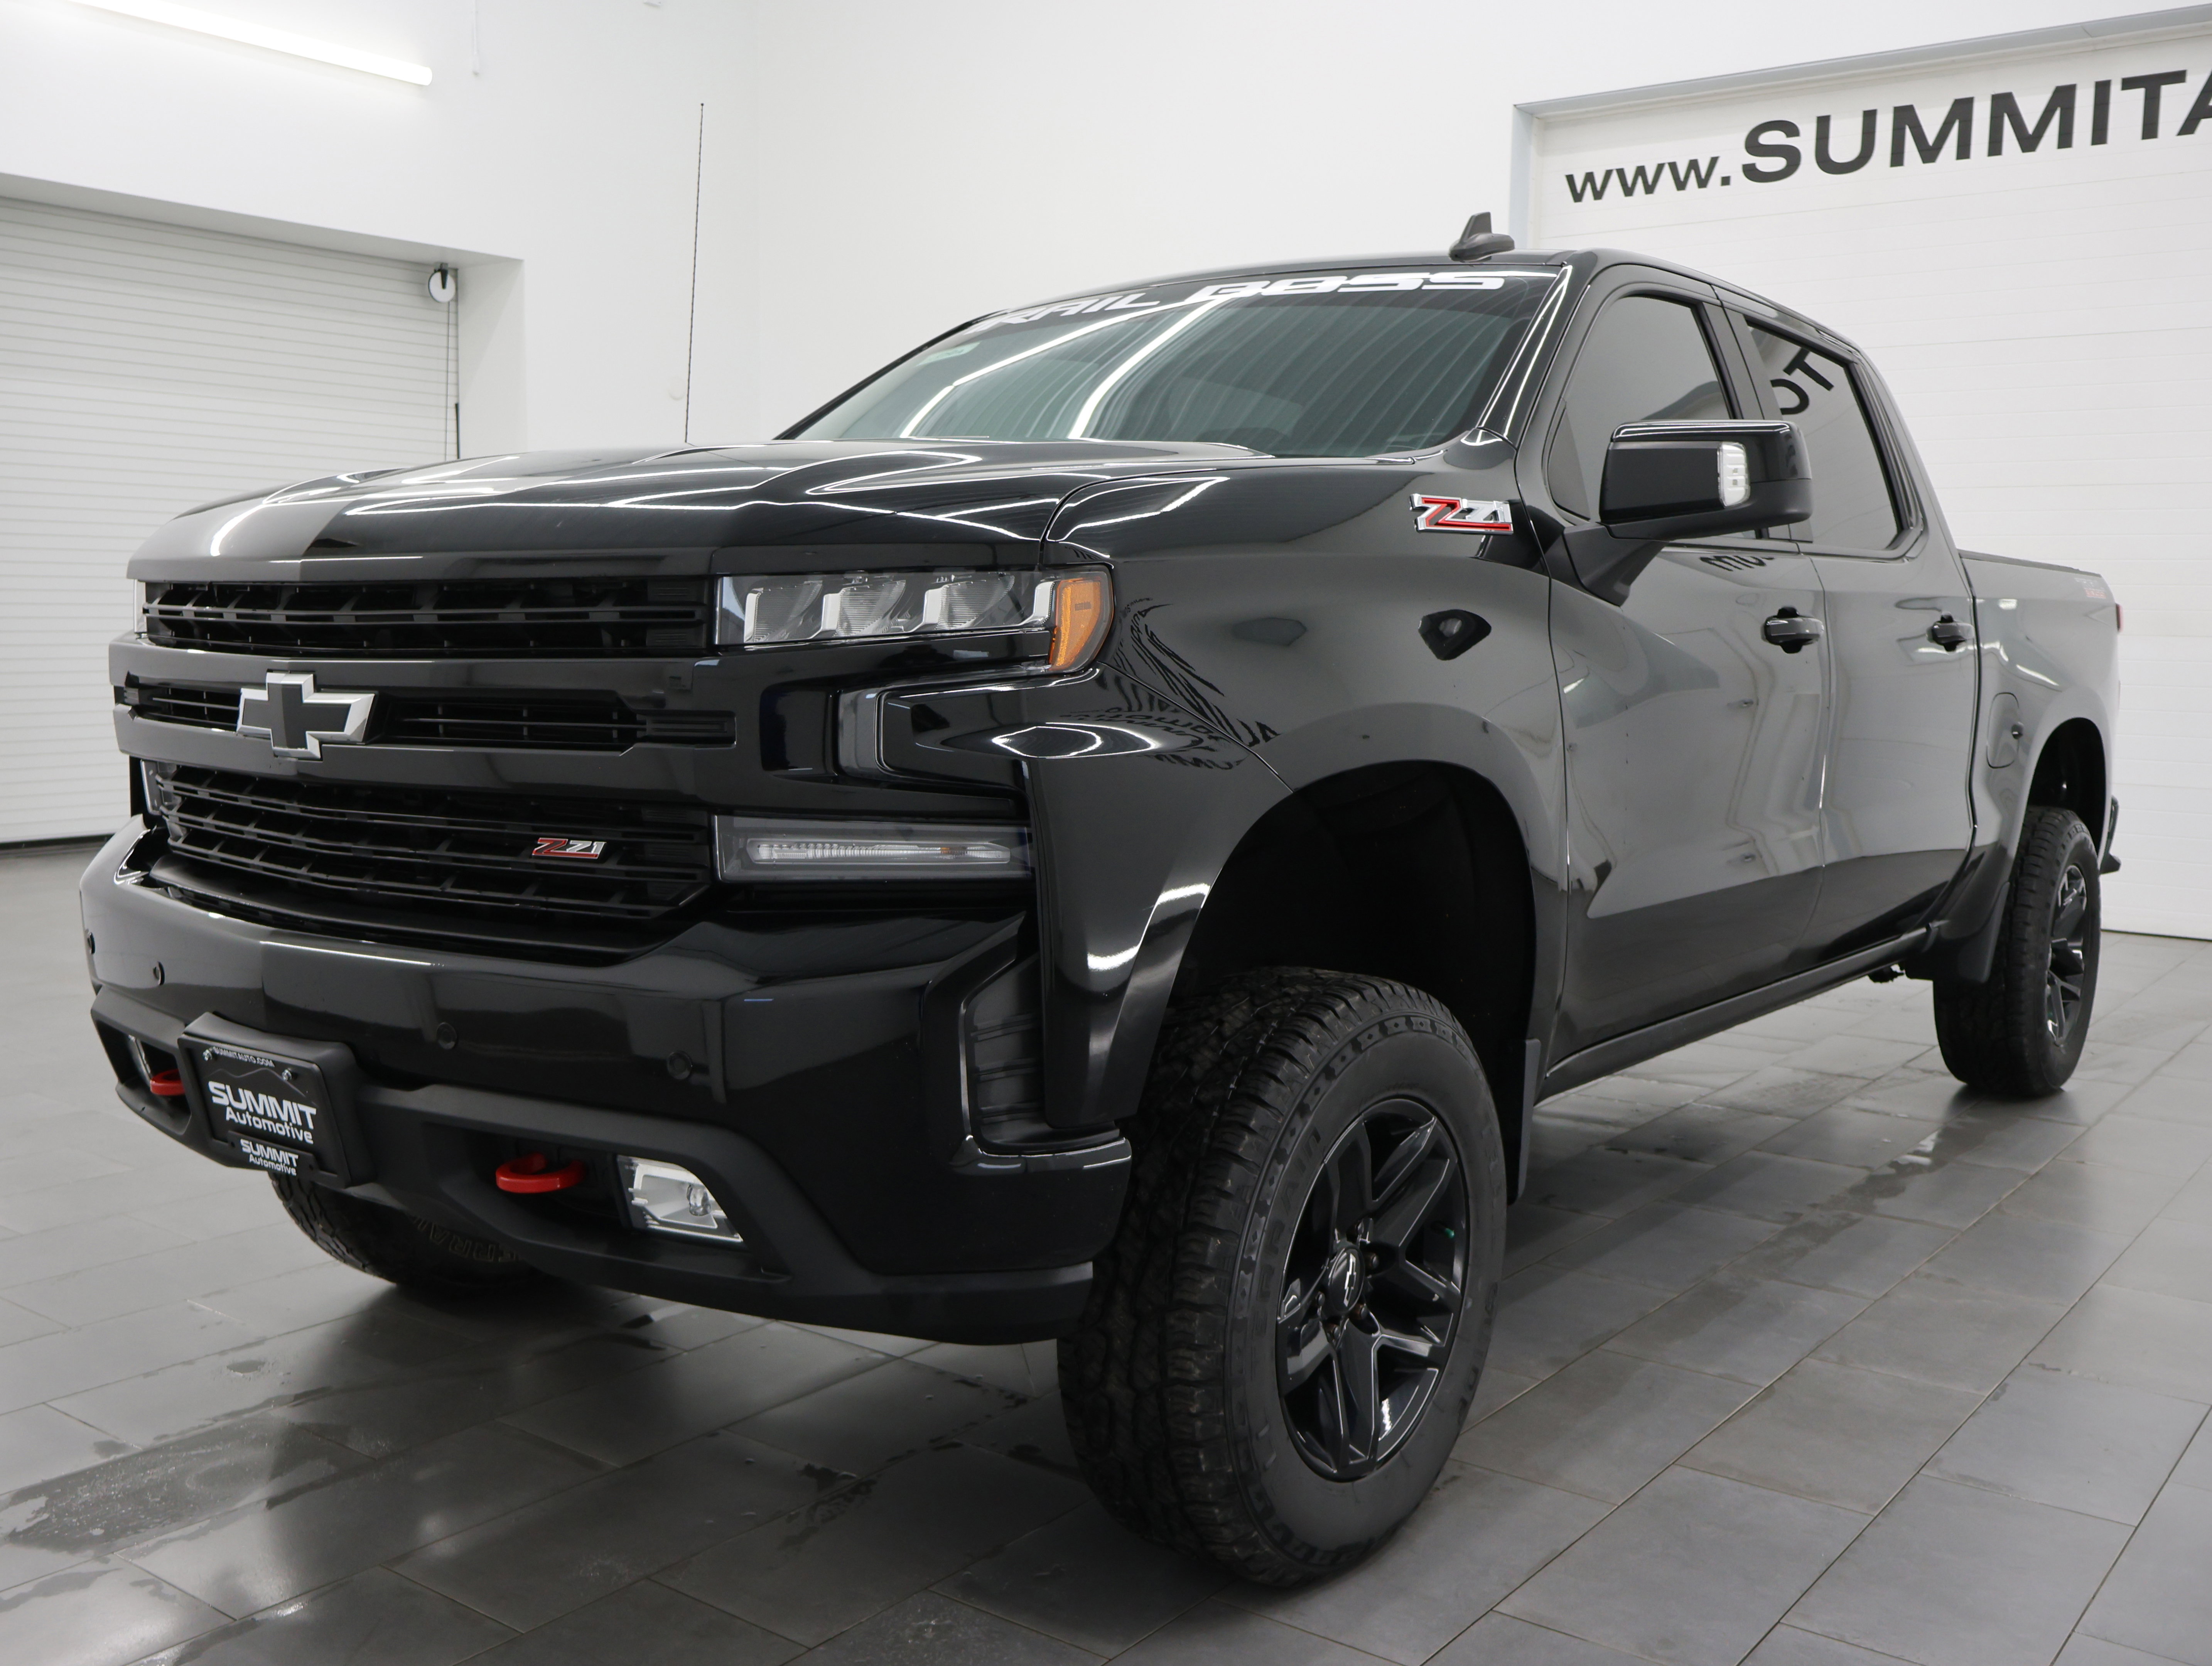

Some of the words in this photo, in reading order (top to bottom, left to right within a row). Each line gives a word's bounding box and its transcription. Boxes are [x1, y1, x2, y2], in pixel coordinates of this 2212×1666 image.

[1409, 493, 1513, 535] Z71
[532, 837, 607, 859] Z71
[208, 1081, 316, 1130] SUMMIT
[226, 1106, 314, 1144] Automotive
[240, 1139, 299, 1167] SUMMIT
[249, 1153, 297, 1176] Automotive
